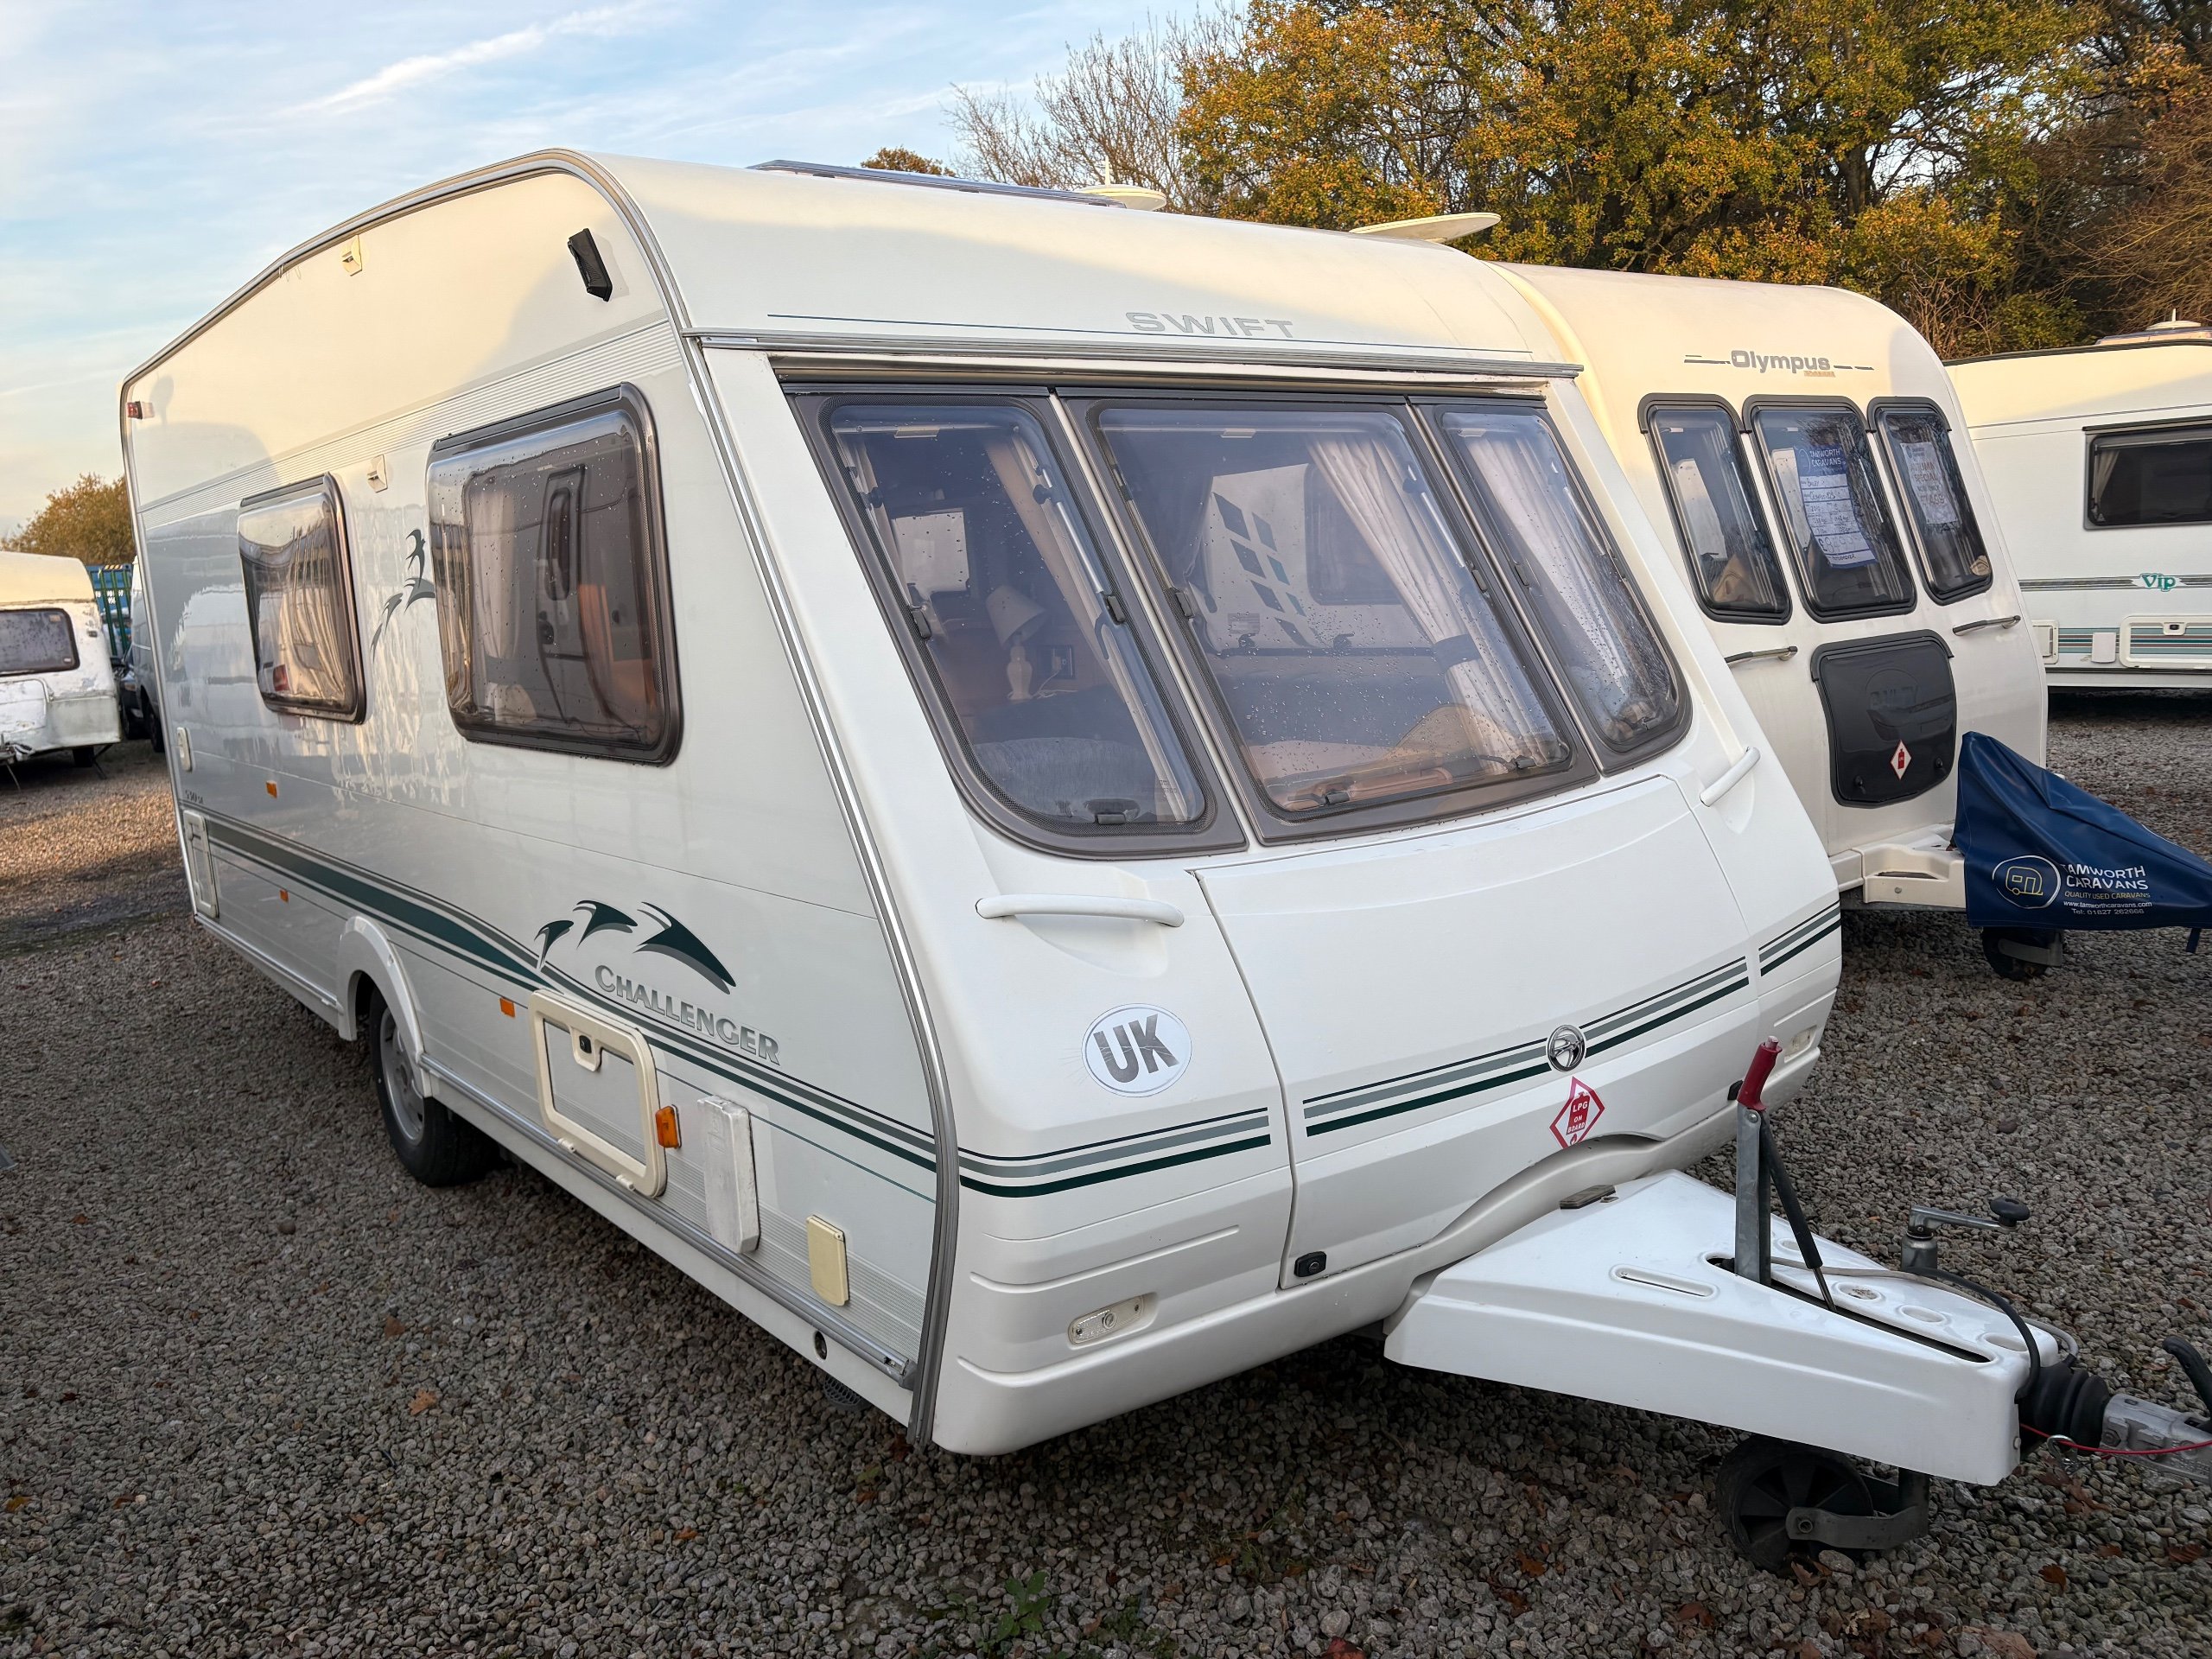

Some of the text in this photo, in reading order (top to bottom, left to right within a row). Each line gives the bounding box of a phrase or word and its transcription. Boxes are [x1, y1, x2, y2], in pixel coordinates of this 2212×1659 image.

[1125, 312, 1294, 338] SWIFT
[1731, 350, 1831, 374] Olympus
[2140, 574, 2177, 591] Vip
[2061, 863, 2146, 879] TAMWORTH
[2066, 874, 2149, 890] CARAVANS
[2064, 890, 2092, 899] QUALITY
[594, 964, 780, 1066] CHALLENGER
[1093, 1013, 1180, 1084] UK
[1573, 1100, 1588, 1113] LPG
[1573, 1115, 1583, 1123] ON
[1567, 1122, 1586, 1133] BOARD
